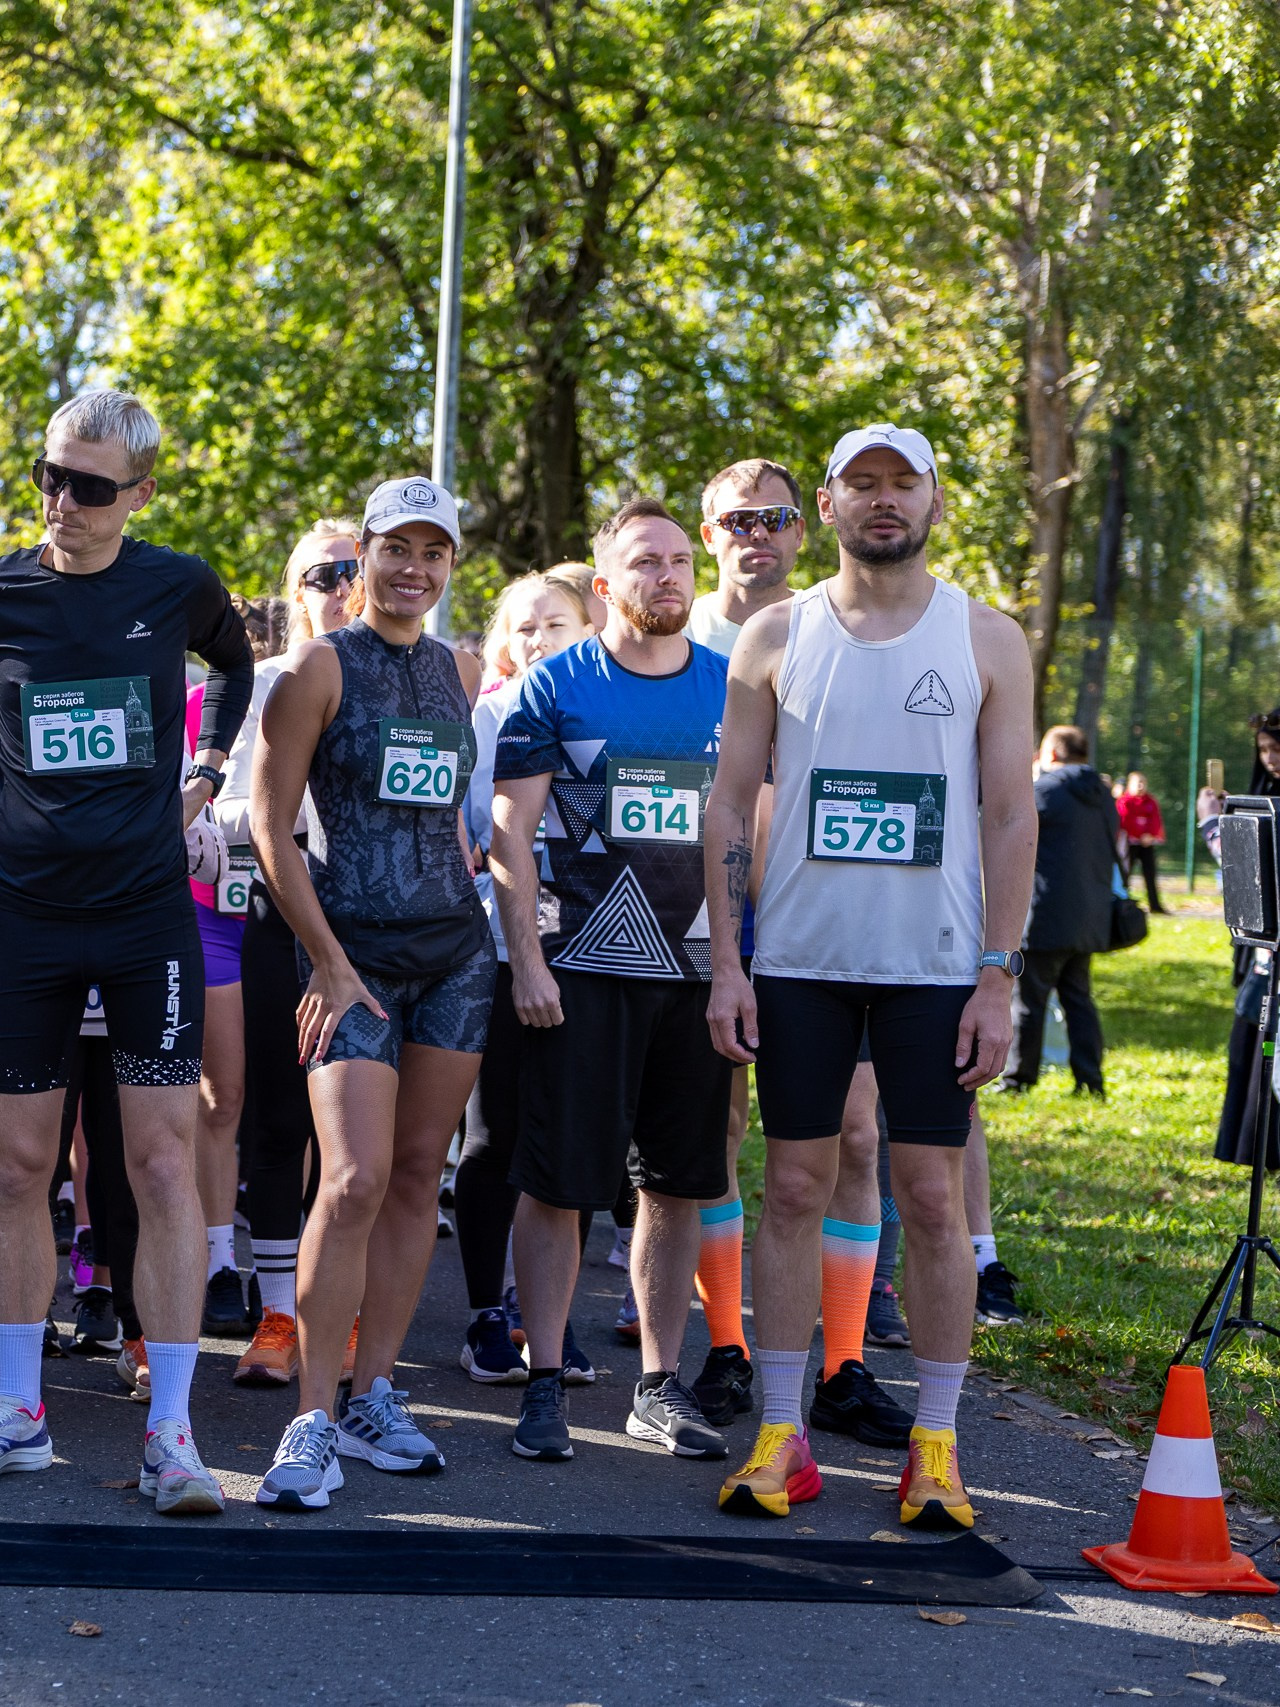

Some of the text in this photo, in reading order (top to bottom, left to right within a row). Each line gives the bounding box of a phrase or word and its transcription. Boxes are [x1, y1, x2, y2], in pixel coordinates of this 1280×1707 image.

[126, 631, 152, 639] DEMIX
[33, 696, 85, 708] 5 городов
[42, 724, 116, 763] 516
[390, 728, 433, 743] 5 городов
[386, 761, 453, 798] 620
[618, 768, 666, 783] 5 городов
[823, 780, 877, 796] 5 городов
[621, 800, 690, 835] 614
[822, 815, 906, 854] 578
[227, 882, 247, 908] 6
